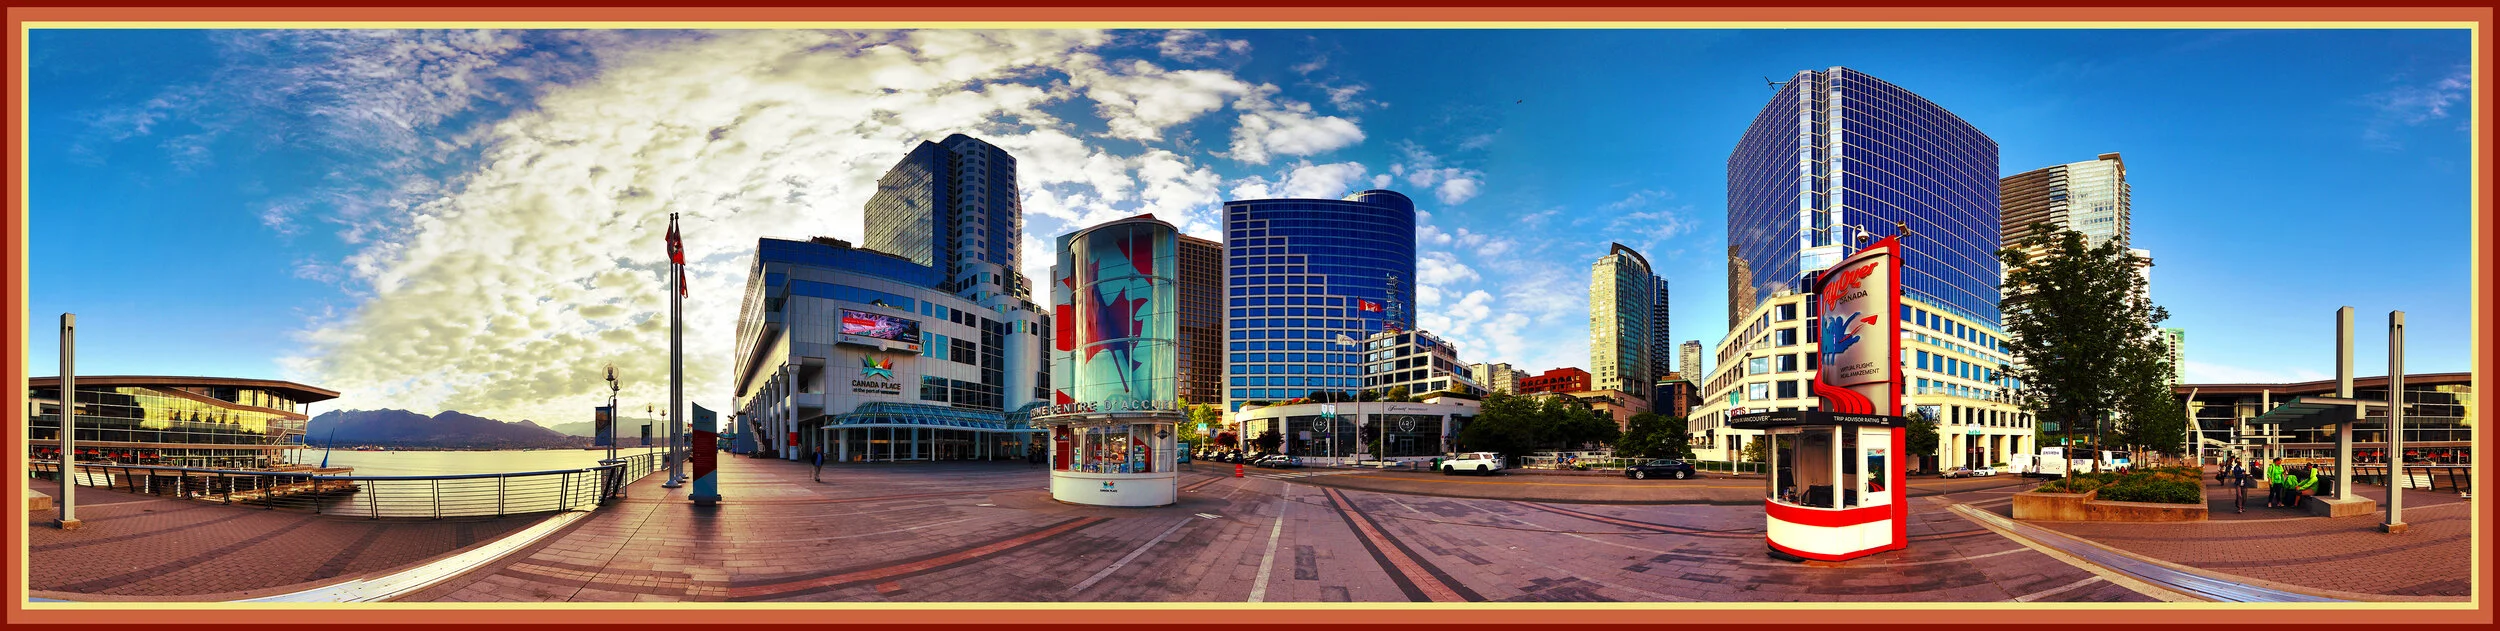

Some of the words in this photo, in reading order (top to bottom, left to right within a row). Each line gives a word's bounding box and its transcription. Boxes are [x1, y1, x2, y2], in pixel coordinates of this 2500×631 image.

[1839, 290, 1868, 304] CANADA
[1850, 368, 1879, 377] AMAZEMENT
[852, 380, 879, 388] CANADA
[881, 382, 901, 390] PLACE
[1050, 401, 1098, 414] CENTRE
